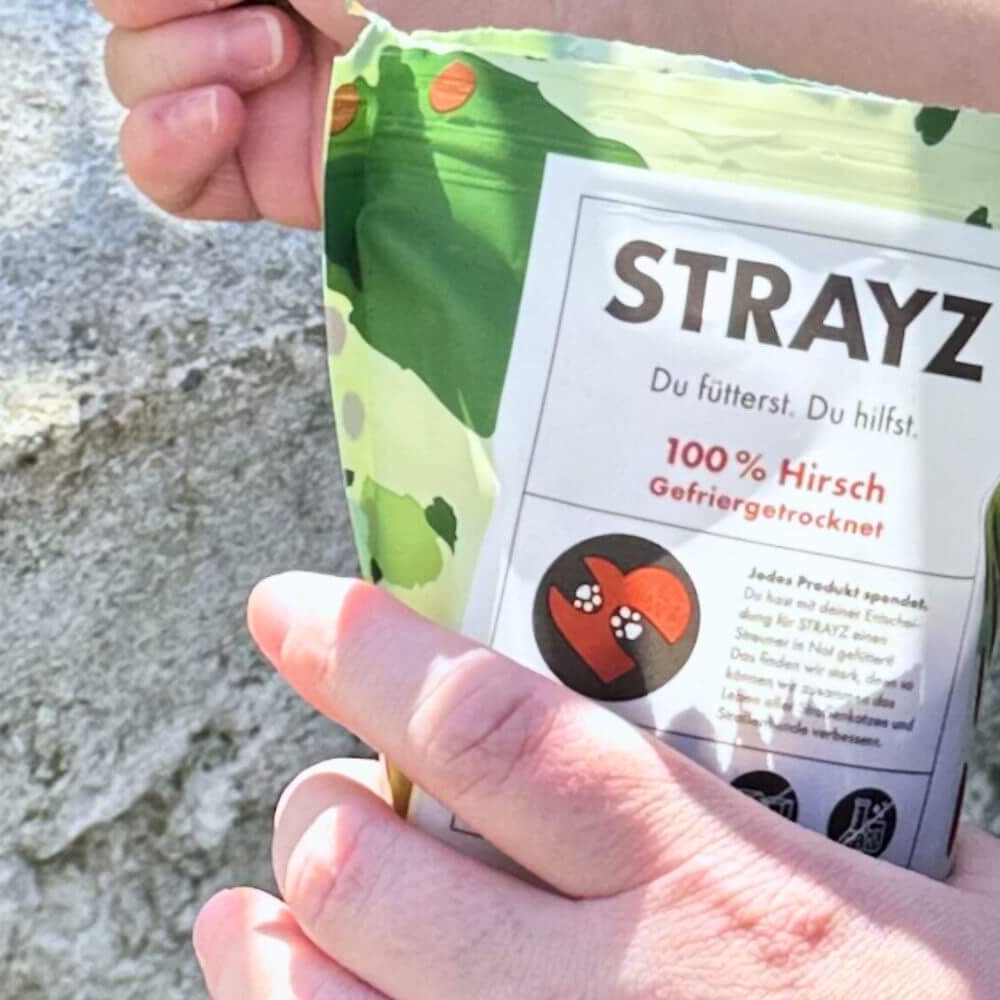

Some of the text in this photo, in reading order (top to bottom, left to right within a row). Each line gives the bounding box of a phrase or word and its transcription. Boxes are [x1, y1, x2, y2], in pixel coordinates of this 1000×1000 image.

[604, 239, 993, 383] STRAYZ
[650, 367, 918, 439] Du fütterst. Du hilfst.
[666, 436, 886, 504] 100 % Hirsch
[649, 476, 884, 538] Gefriergetrocknet
[748, 566, 792, 586] Jedes
[797, 575, 860, 599] Produkt
